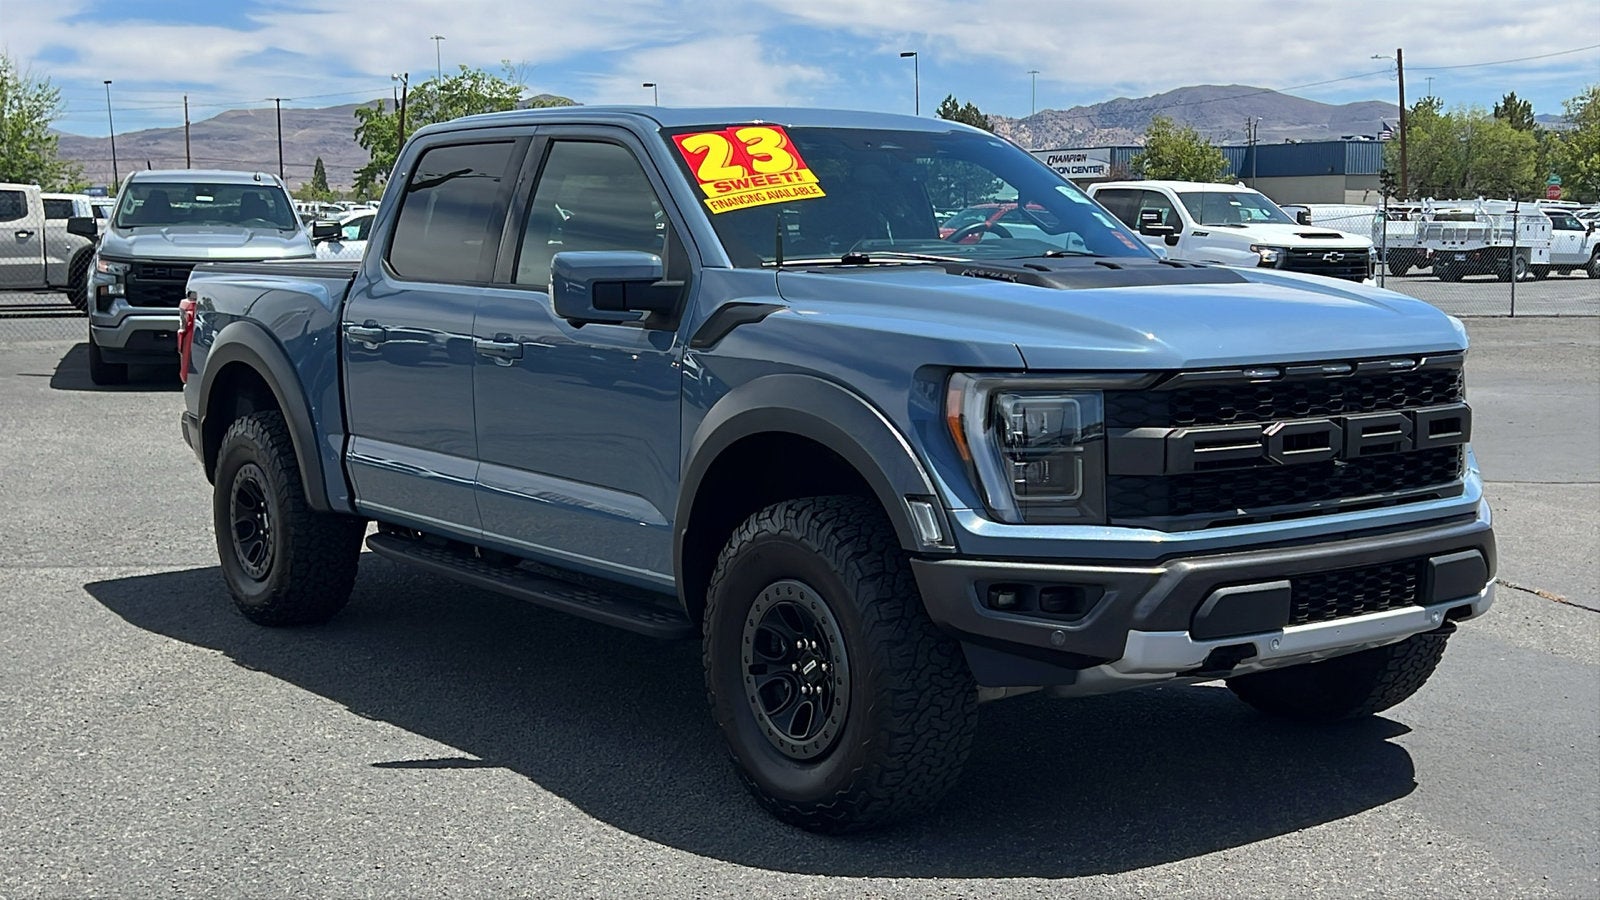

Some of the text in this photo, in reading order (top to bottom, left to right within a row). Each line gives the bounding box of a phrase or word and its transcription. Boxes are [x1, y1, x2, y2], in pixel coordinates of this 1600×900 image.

[681, 127, 798, 181] 23
[1047, 154, 1087, 166] CHAMPION
[1071, 165, 1104, 175] CENTER
[714, 171, 804, 193] SWEET!
[710, 185, 819, 210] FINANCING AVAILABLE
[1165, 401, 1472, 475] FORD
